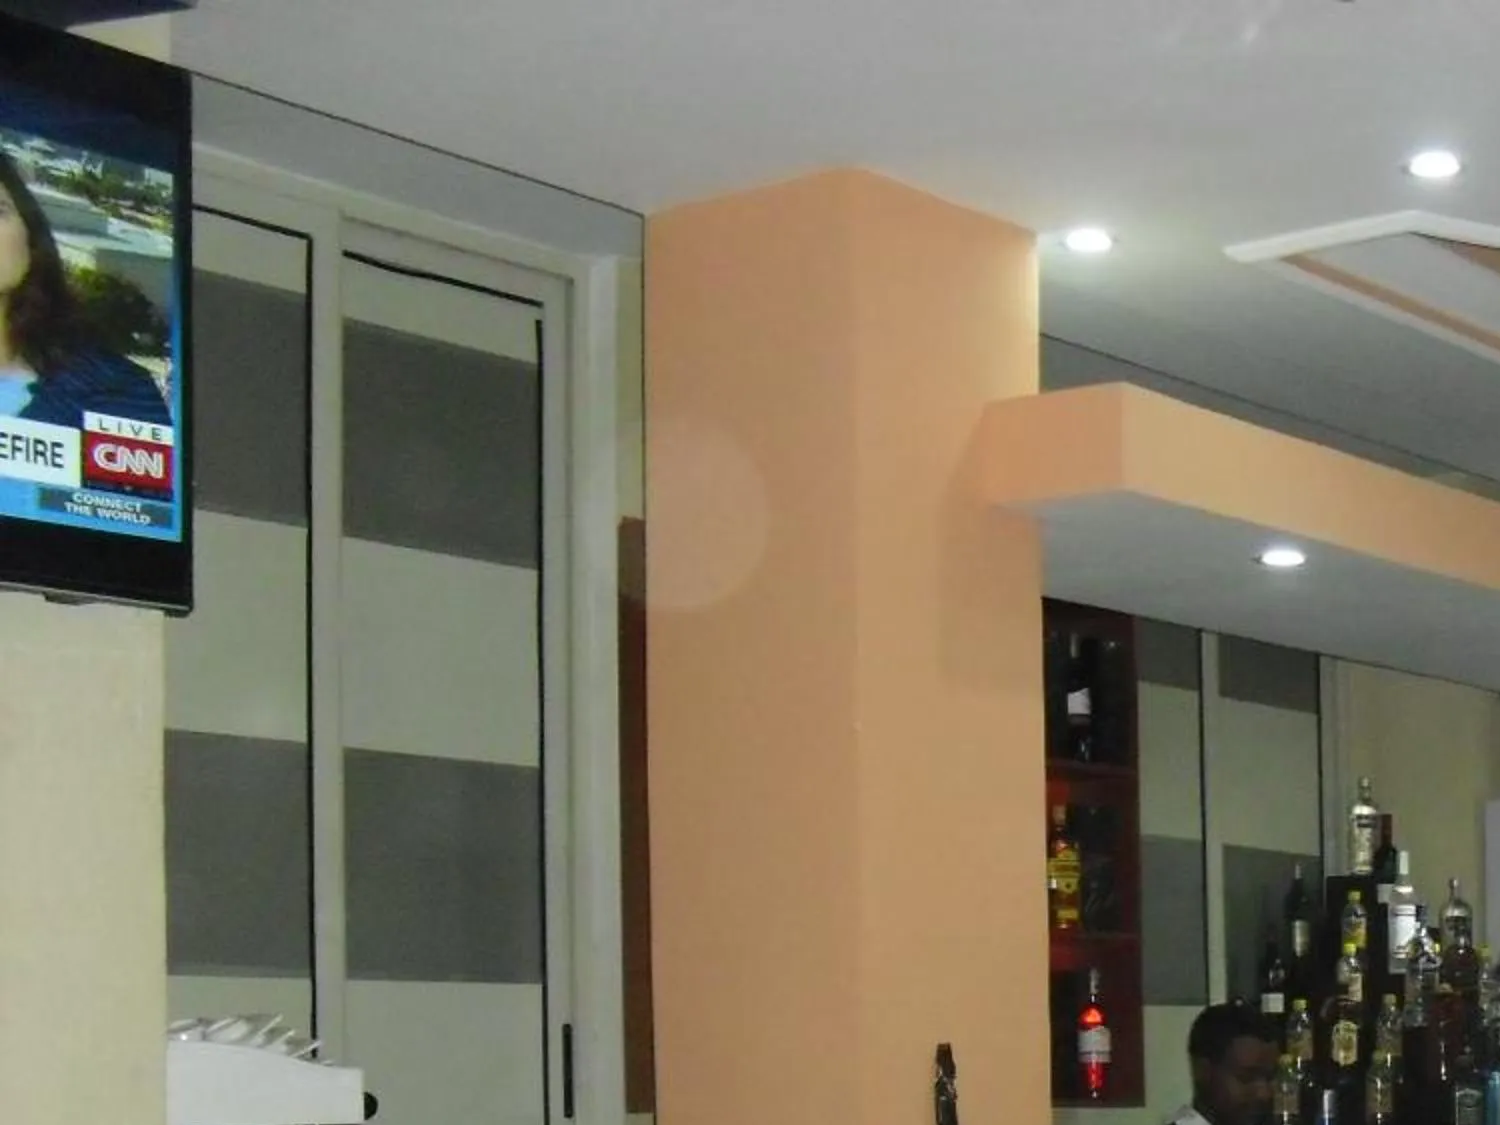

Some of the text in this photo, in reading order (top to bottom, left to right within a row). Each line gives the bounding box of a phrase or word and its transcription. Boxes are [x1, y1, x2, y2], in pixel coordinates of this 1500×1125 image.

[98, 418, 162, 441] LIVE
[93, 443, 164, 479] CNN
[64, 502, 152, 525] THE WORLD
[72, 492, 143, 513] CONNECT
